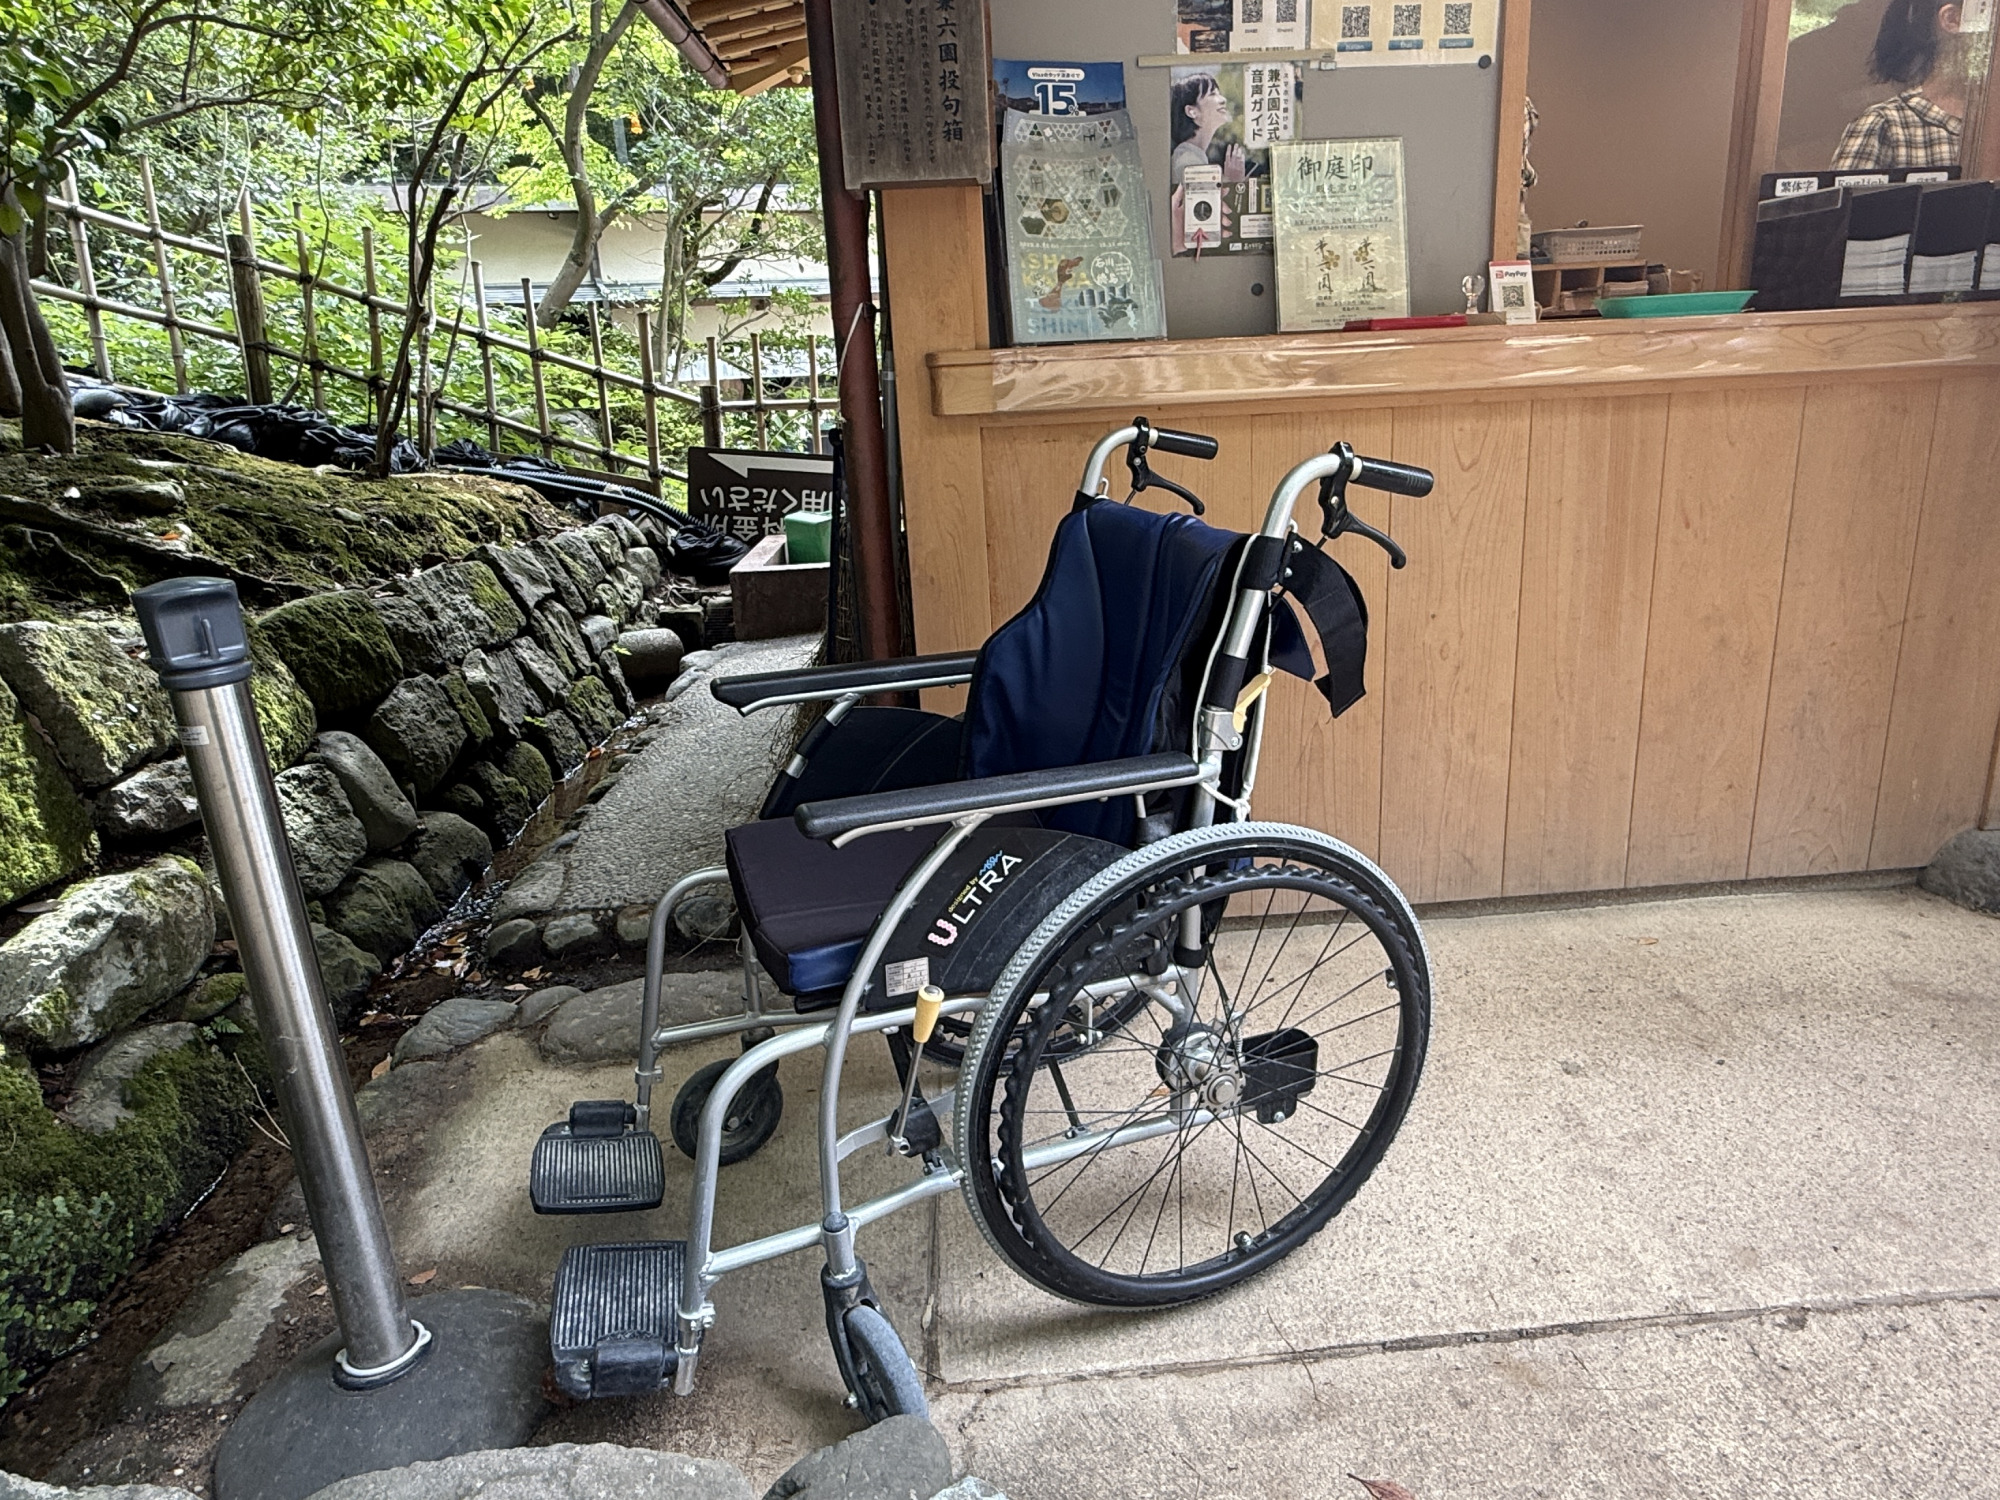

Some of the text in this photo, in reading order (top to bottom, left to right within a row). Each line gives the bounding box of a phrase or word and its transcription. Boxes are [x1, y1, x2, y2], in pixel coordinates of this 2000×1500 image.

[1251, 69, 1264, 141] 音声ガイド
[1267, 69, 1280, 140] 兼六園公式
[1297, 155, 1373, 181] 御庭印
[1781, 180, 1815, 193] 繁体字
[700, 486, 832, 514] 用ください
[704, 514, 785, 542] 料金所
[928, 854, 1023, 946] ULTRA
[948, 884, 972, 913] designed
